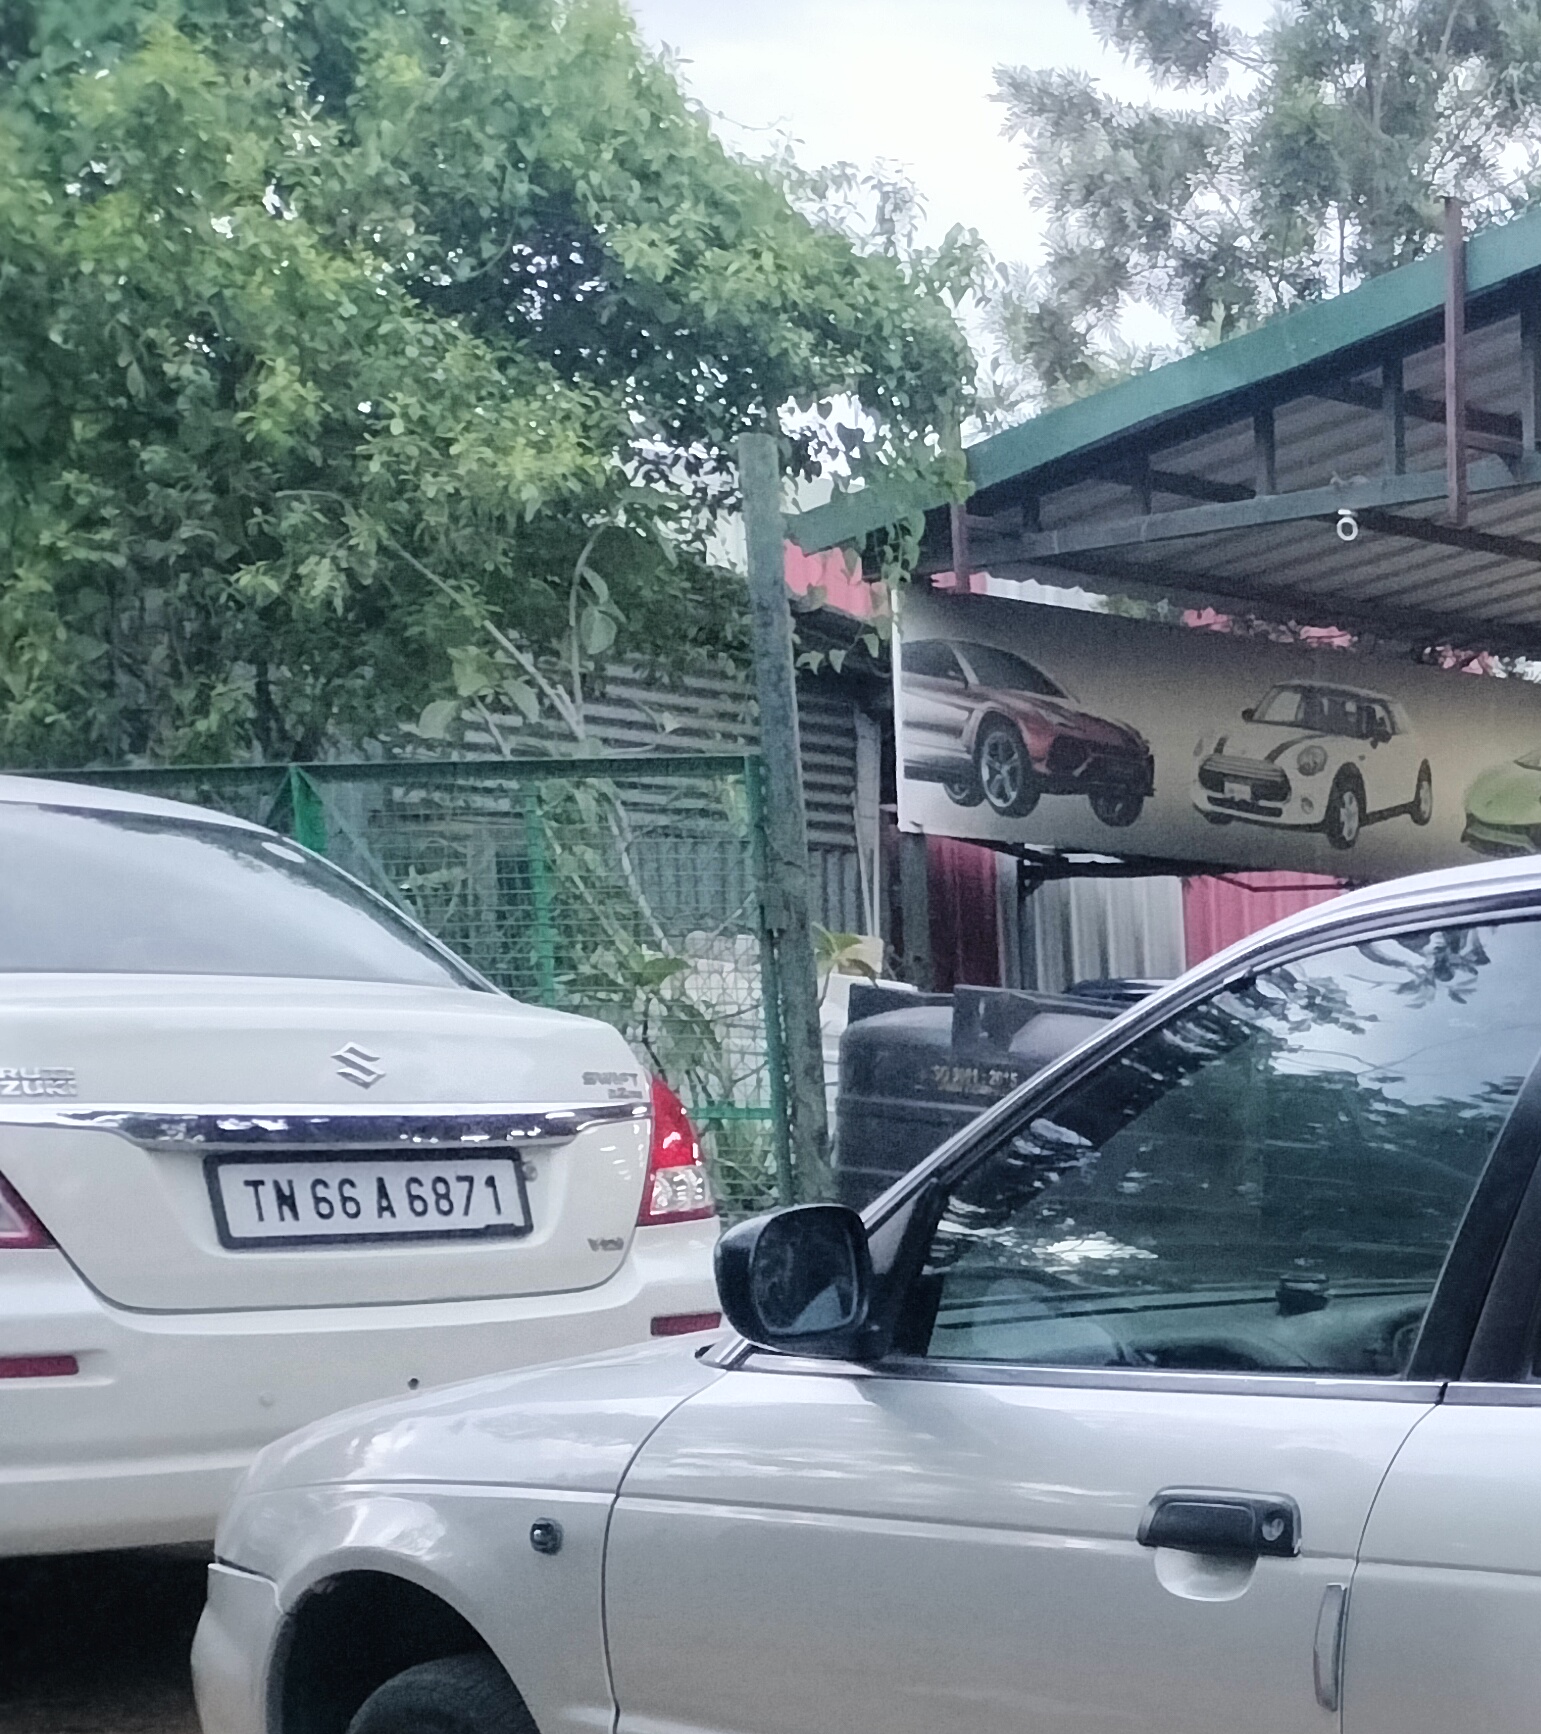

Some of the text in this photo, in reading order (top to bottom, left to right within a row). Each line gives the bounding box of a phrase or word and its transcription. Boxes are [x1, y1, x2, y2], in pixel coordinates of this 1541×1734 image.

[243, 1175, 502, 1222] TN 66 A 6871
